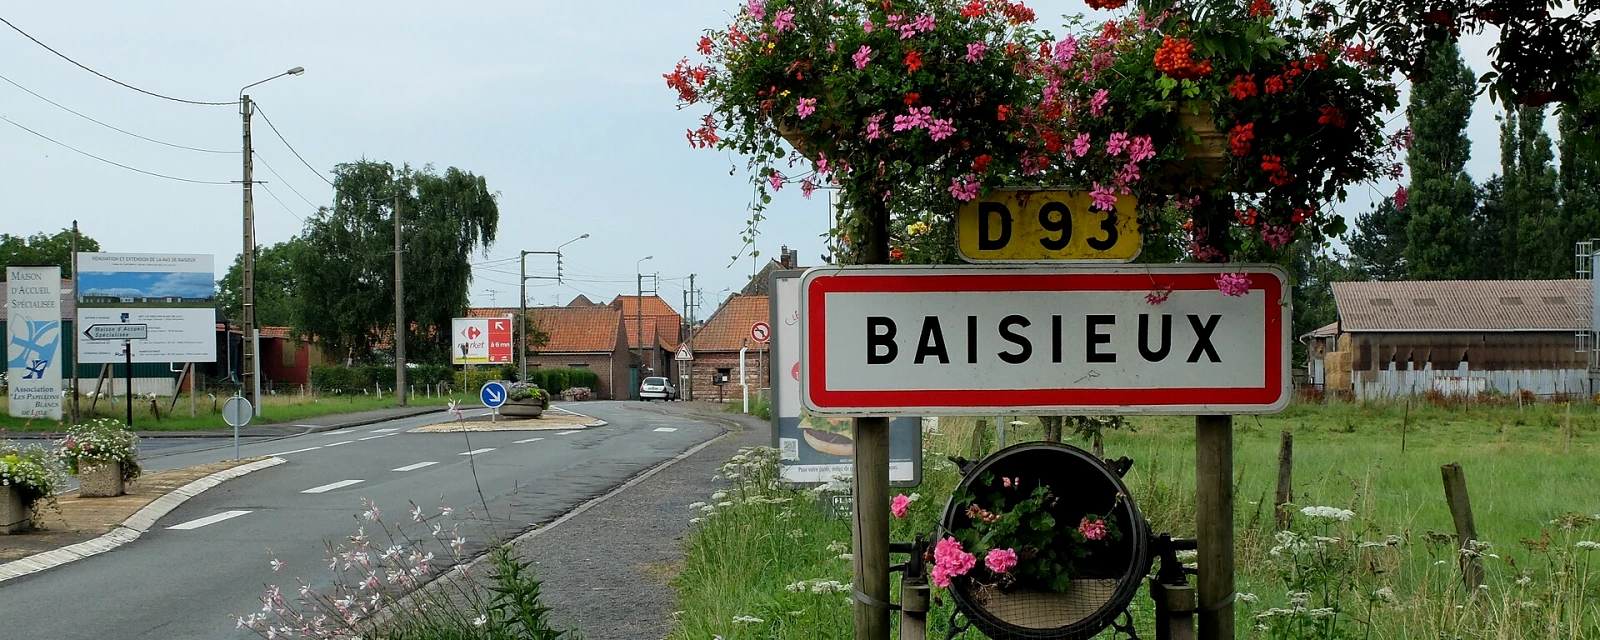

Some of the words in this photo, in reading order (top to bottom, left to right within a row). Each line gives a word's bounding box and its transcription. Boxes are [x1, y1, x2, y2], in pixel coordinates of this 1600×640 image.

[977, 200, 1012, 251] D
[1038, 200, 1119, 251] 93
[11, 271, 42, 280] MAISON
[866, 313, 1222, 364] BAISIEUX
